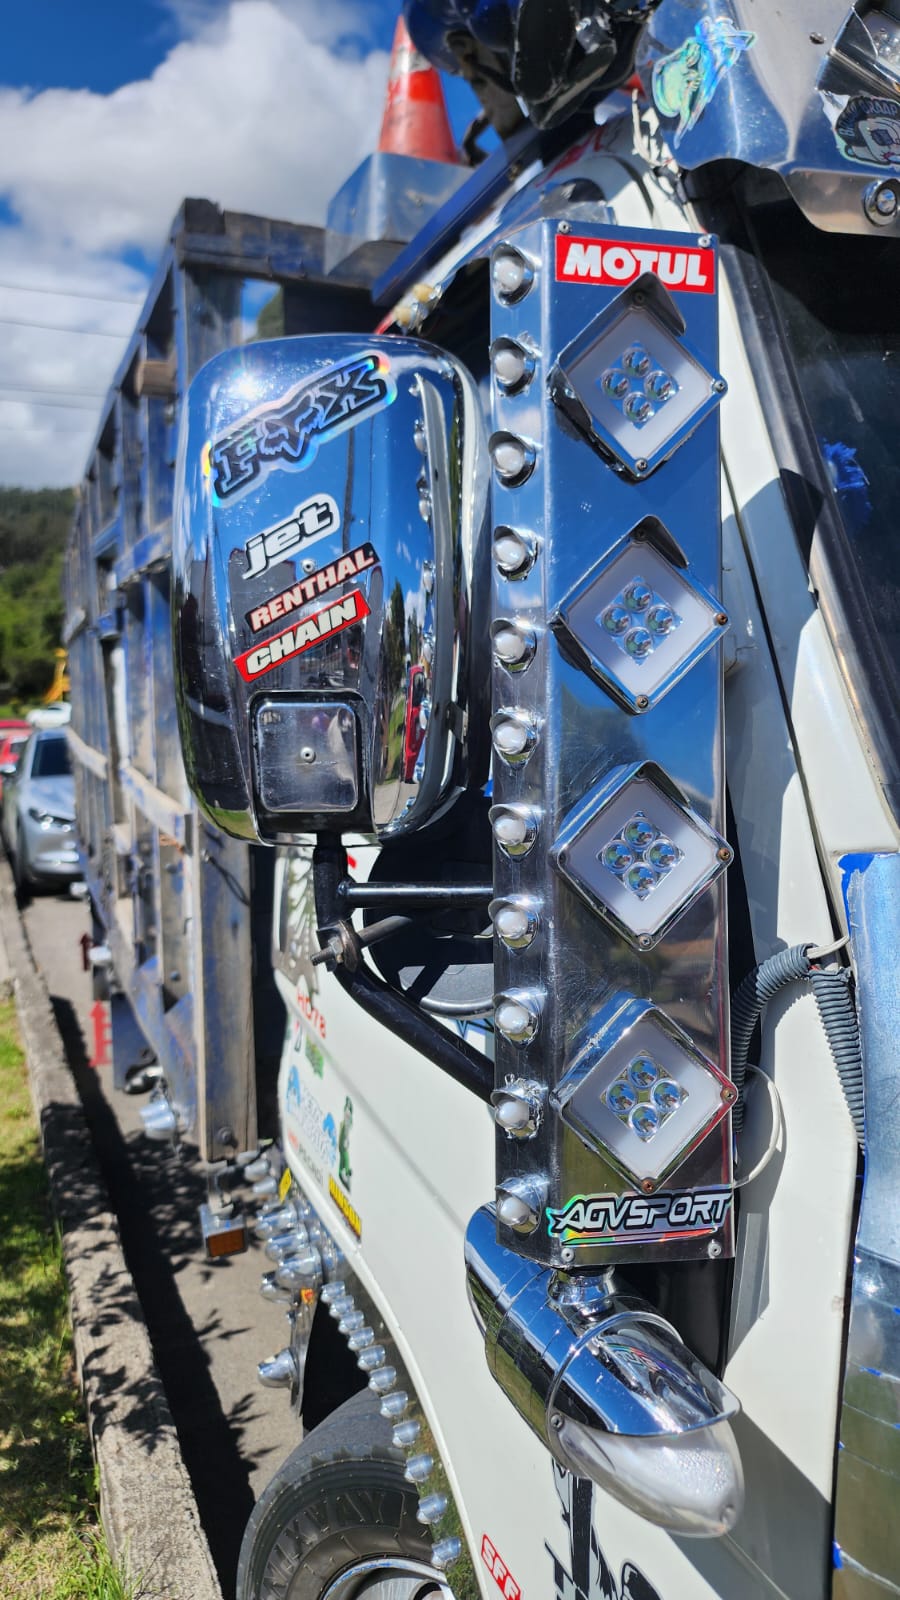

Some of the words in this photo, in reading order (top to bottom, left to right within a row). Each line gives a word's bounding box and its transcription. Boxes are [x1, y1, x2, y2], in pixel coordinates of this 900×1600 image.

[563, 243, 707, 286] MOTUL
[211, 355, 388, 499] FOX
[245, 501, 334, 578] jet
[250, 550, 374, 631] RENTHAL
[246, 596, 358, 675] CHAIN
[553, 1193, 732, 1231] AGVSPORT
